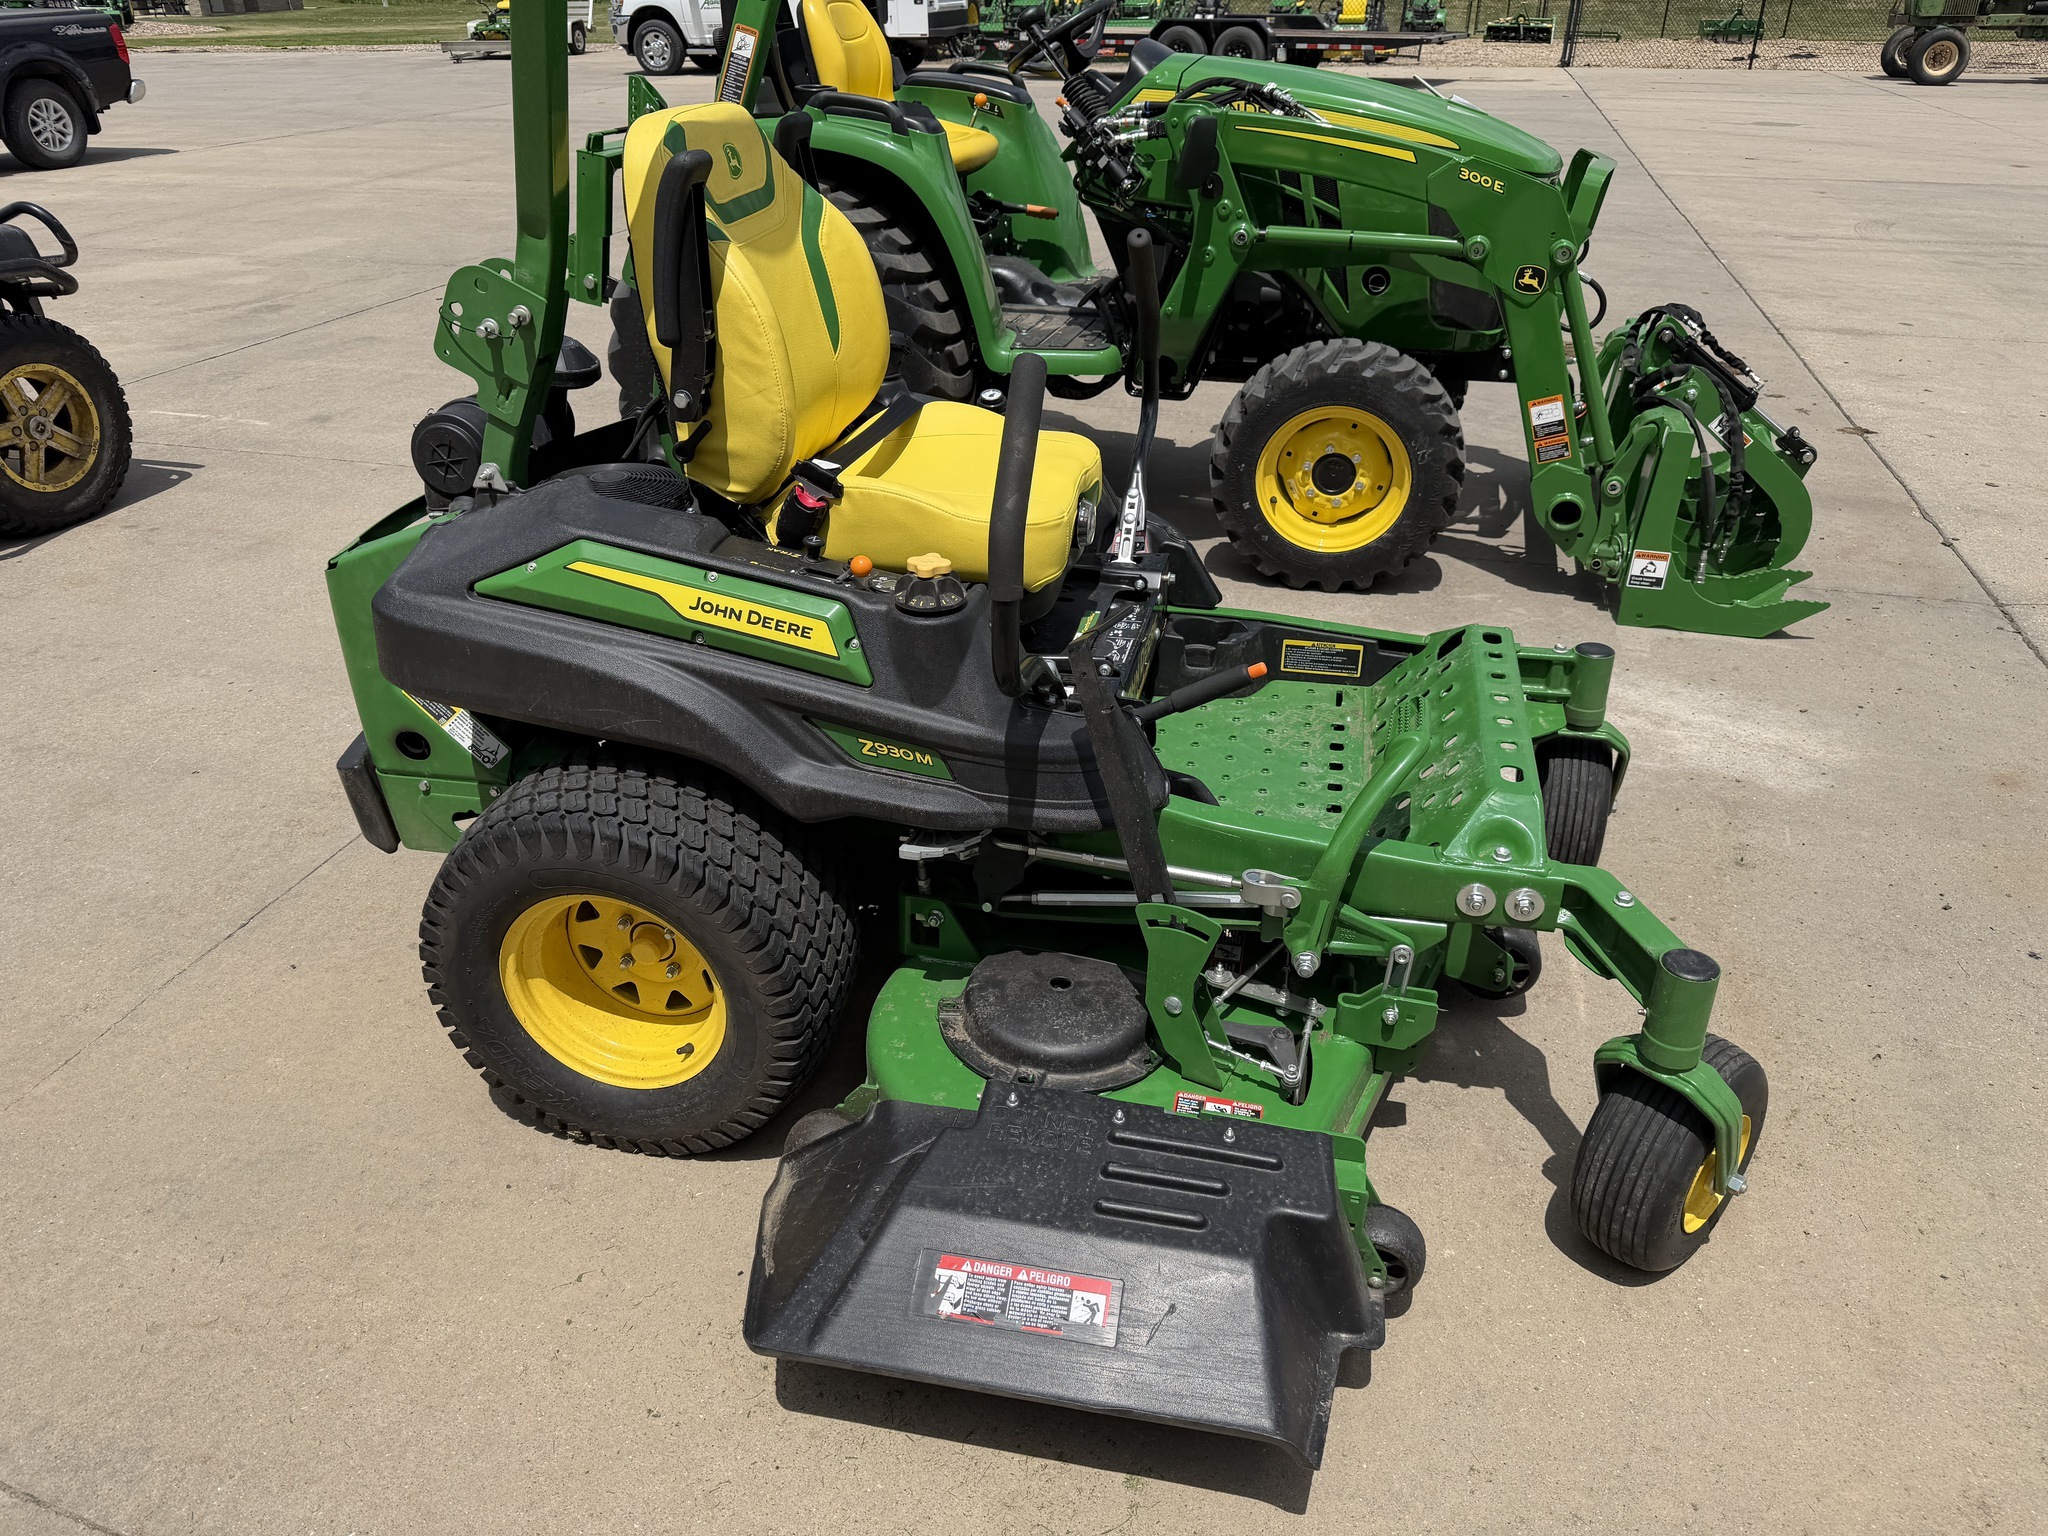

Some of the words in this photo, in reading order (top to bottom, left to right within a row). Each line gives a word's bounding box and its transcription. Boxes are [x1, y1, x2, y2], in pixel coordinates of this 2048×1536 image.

[688, 596, 742, 622] JOHN
[746, 610, 813, 640] DEERE
[1183, 1092, 1206, 1101] DANGER
[1237, 1101, 1262, 1111] PELIGRO
[1044, 1112, 1098, 1136] NOT
[986, 1122, 1094, 1154] REMOVE
[973, 1262, 1013, 1278] DANGER
[1029, 1271, 1071, 1287] PELIGRO
